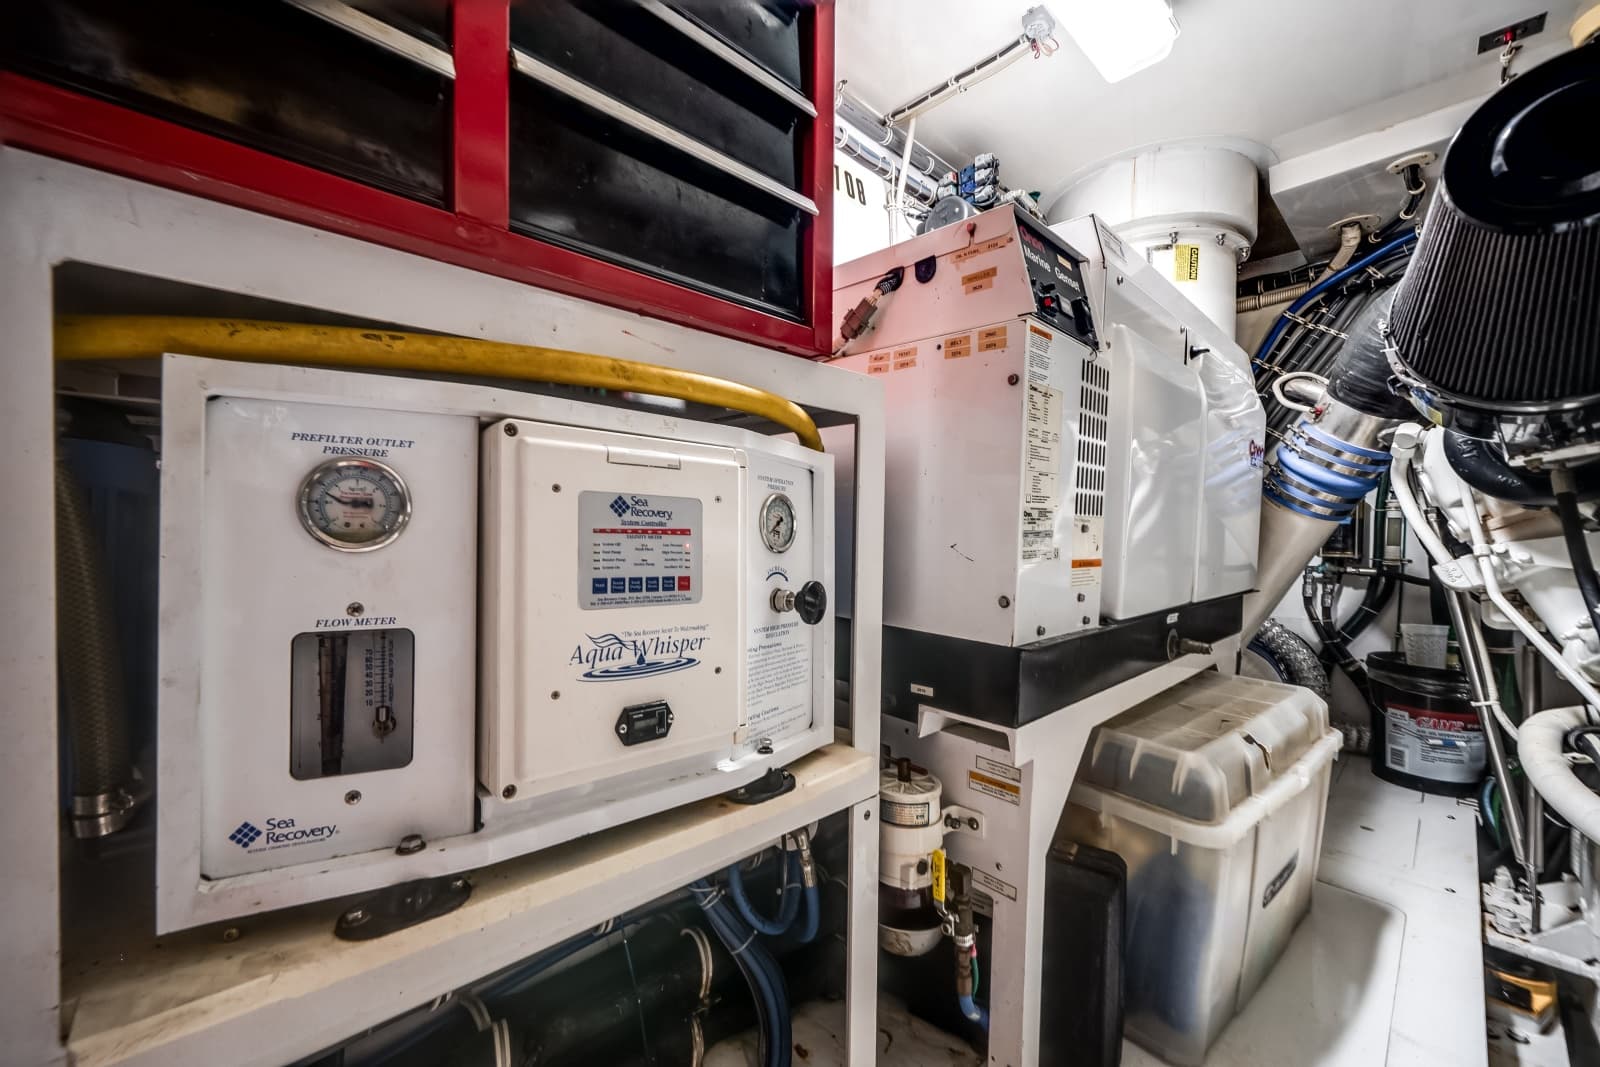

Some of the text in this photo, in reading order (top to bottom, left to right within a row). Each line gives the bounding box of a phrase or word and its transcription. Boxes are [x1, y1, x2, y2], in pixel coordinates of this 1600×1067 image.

[1023, 245, 1052, 273] Marine
[1189, 248, 1199, 280] CAUTION
[291, 432, 415, 449] PREFILTER OUTLET
[323, 445, 389, 458] PRESSURE
[631, 495, 649, 507] Sea
[631, 506, 673, 521] Recovery
[620, 519, 640, 527] System
[315, 616, 397, 628] FLOW METER
[569, 635, 706, 670] Aqua Whisper
[266, 817, 295, 831] Sea
[266, 824, 337, 845] Recovery
